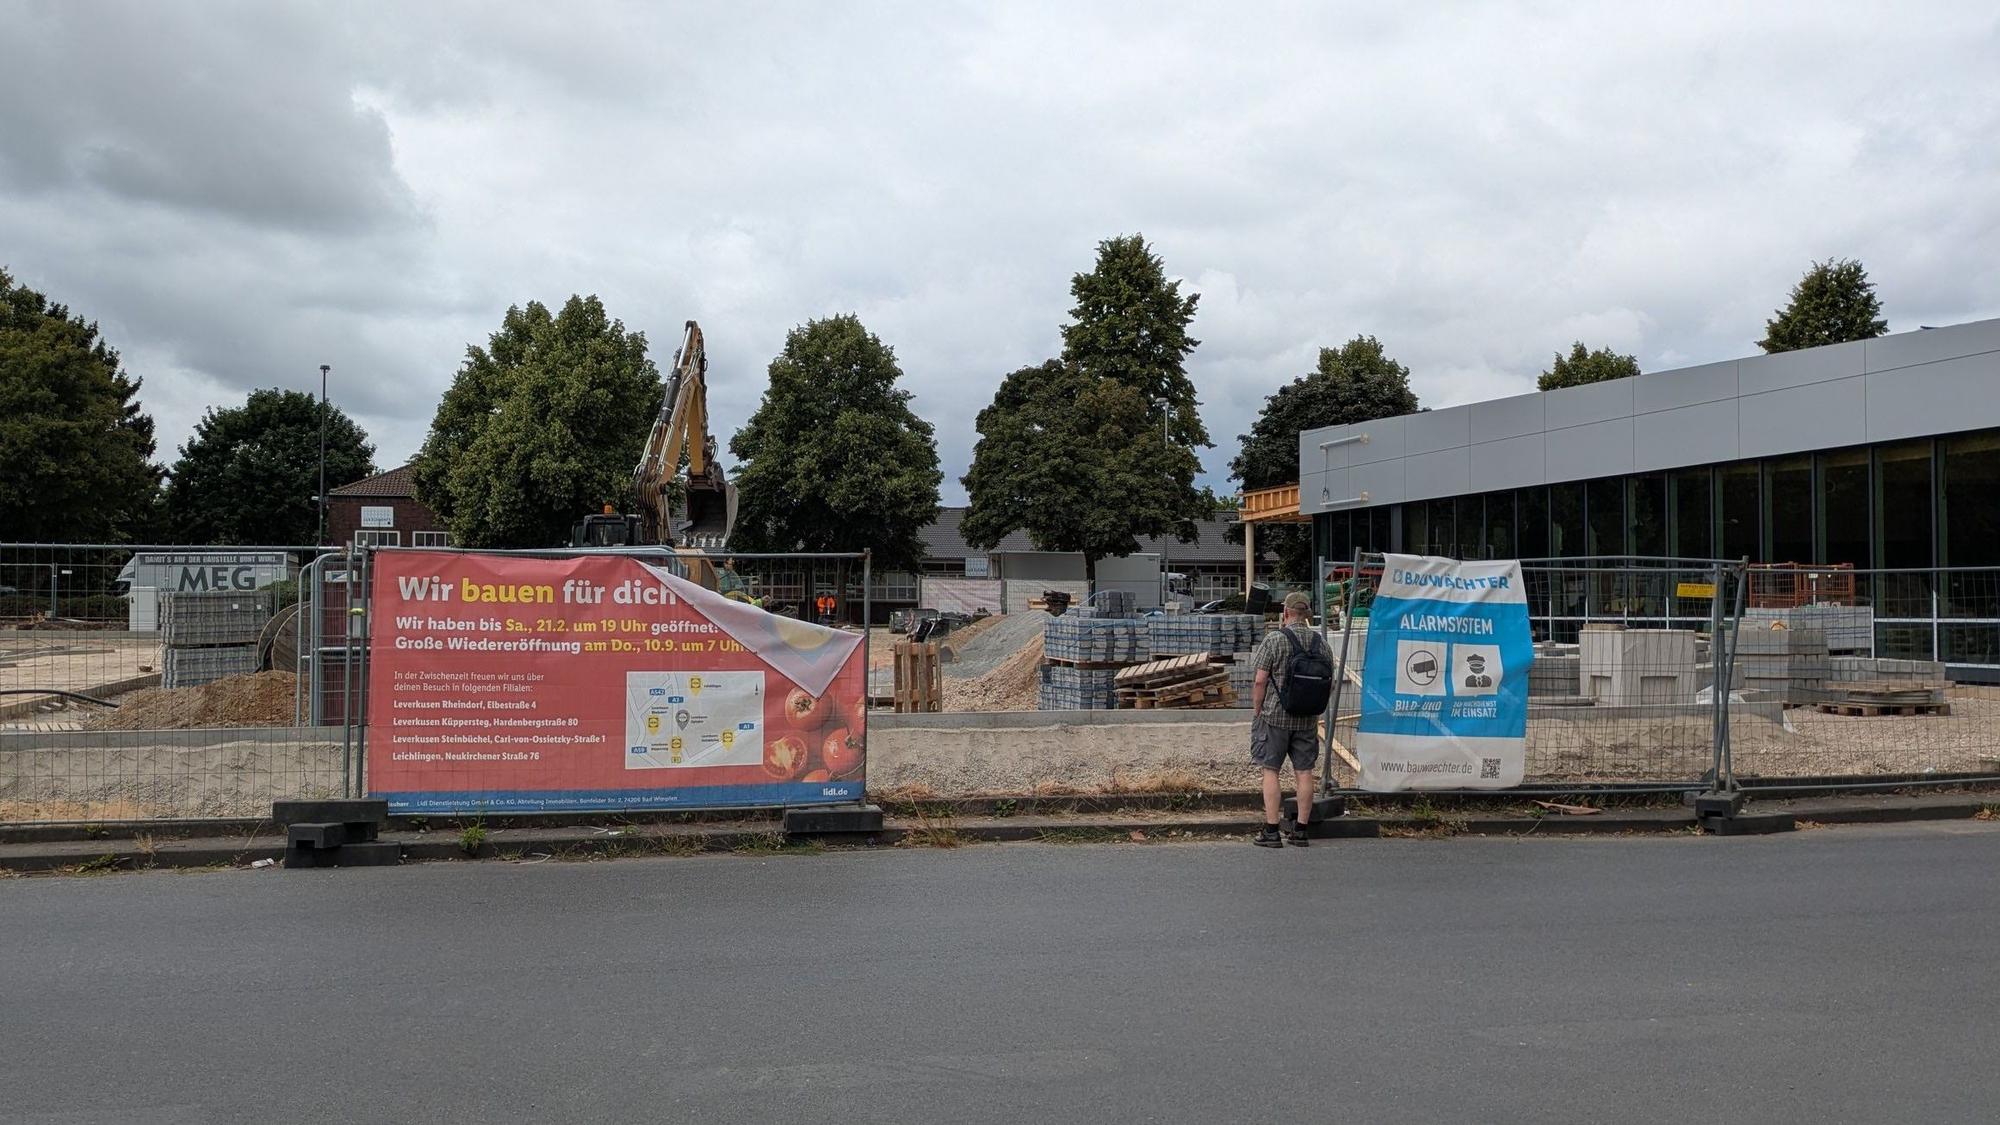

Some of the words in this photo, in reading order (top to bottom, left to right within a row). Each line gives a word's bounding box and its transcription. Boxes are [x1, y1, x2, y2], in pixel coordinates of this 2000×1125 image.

[178, 566, 256, 592] MEG
[398, 576, 454, 602] Wir
[461, 578, 554, 603] bauen
[562, 579, 606, 604] für
[613, 580, 676, 605] dich
[396, 616, 424, 630] Wir
[428, 616, 476, 631] haben
[479, 618, 502, 632] bis
[506, 618, 532, 633] Sa.,
[536, 618, 569, 632] 21.2.
[573, 622, 596, 632] um
[600, 618, 616, 632] 19
[620, 619, 648, 632] Uhr
[651, 620, 718, 636] geöffnet:
[1400, 614, 1494, 635] ALARMSYSTEM
[395, 636, 444, 650] Große
[447, 636, 581, 654] Wiedereröffnung
[584, 641, 606, 651] am
[610, 639, 641, 654] Do.,
[644, 639, 678, 652] 10.9.
[682, 642, 704, 652] um
[708, 640, 718, 652] 7
[394, 671, 403, 680] In
[405, 672, 418, 680] der
[419, 672, 469, 680] Zwischenzeit
[470, 672, 496, 681] freuen
[497, 673, 510, 681] wir
[526, 672, 544, 682] über
[394, 683, 421, 692] deinen
[423, 684, 450, 692] Besuch
[452, 684, 460, 692] in
[462, 684, 500, 694] folgenden
[502, 684, 533, 692] Filialen:
[394, 700, 440, 709] Leverkusen
[442, 700, 486, 710] Rheindorf,
[487, 701, 530, 710] Elbestraße
[531, 702, 536, 710] 4
[1394, 700, 1420, 711] BILD-
[1450, 708, 1461, 717] IM
[1462, 708, 1497, 718] EINSATZ
[393, 718, 440, 726] Leverkusen
[442, 718, 492, 728] Küppersteg,
[493, 718, 566, 728] Hardenbergstraße
[568, 718, 578, 726] 80
[392, 735, 440, 744] Leverkusen
[441, 735, 492, 744] Steinbüchel,
[494, 736, 600, 746] Carl-von-Ossietzky-Straße
[601, 735, 606, 743] 1
[392, 752, 444, 762] Leichlingen,
[445, 752, 500, 761] Neukirchener
[502, 752, 528, 760] Straße
[530, 752, 540, 760] 76
[1380, 760, 1473, 774] www.bauwaechter.de
[822, 788, 848, 796] lidl.de
